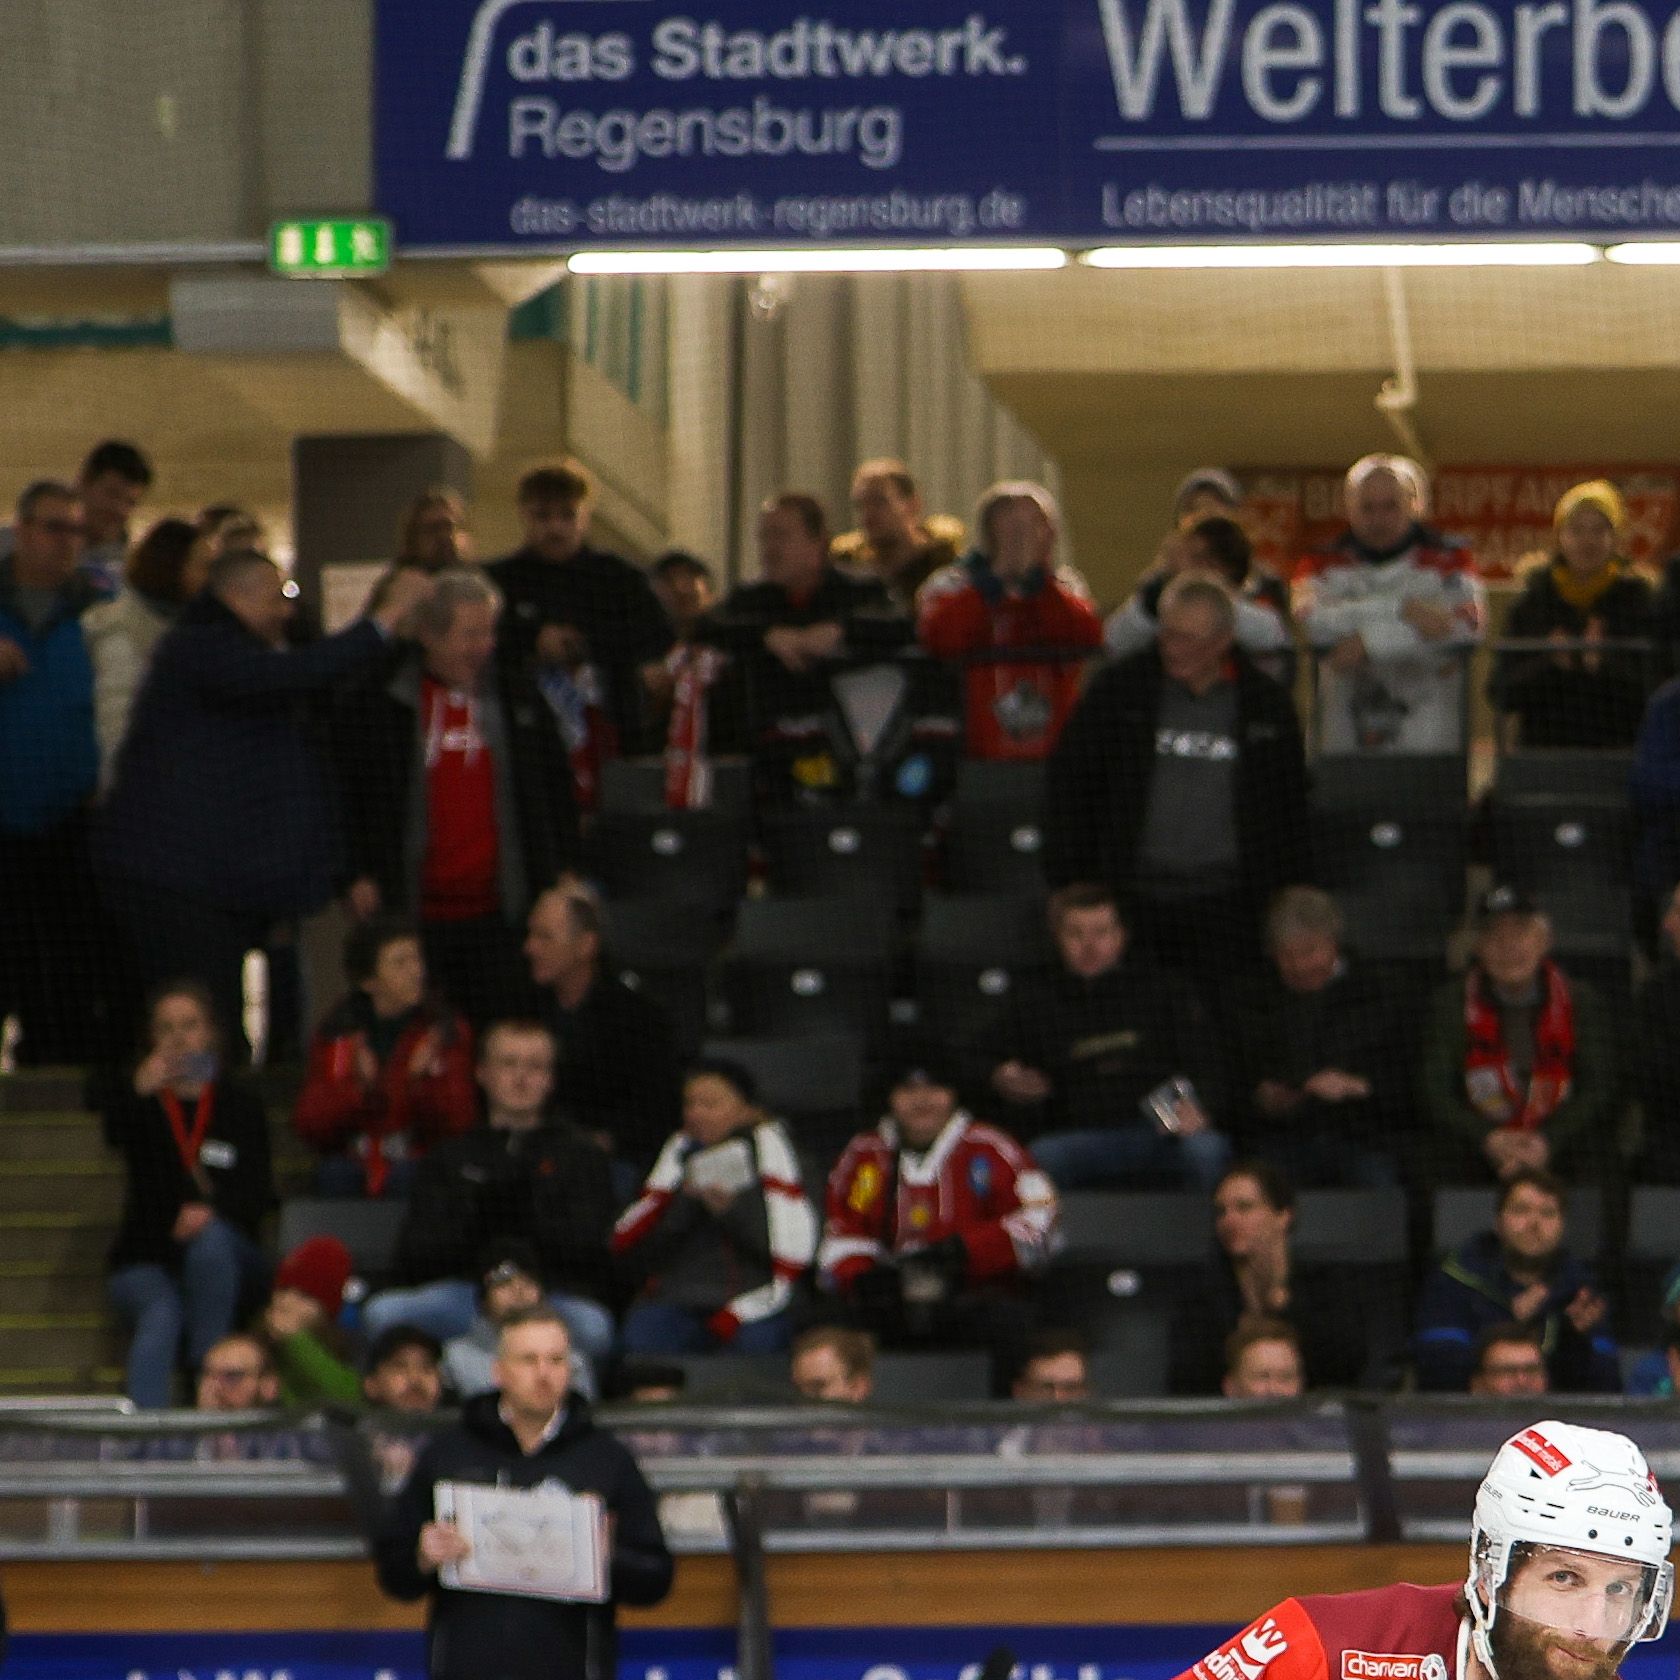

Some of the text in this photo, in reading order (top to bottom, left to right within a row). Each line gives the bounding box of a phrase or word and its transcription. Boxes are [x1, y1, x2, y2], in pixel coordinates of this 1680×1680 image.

[507, 15, 1028, 83] das Stadtwerk.
[508, 96, 904, 173] Regensburg
[1101, 182, 1376, 231] Lebensqualität
[1448, 181, 1508, 223] die
